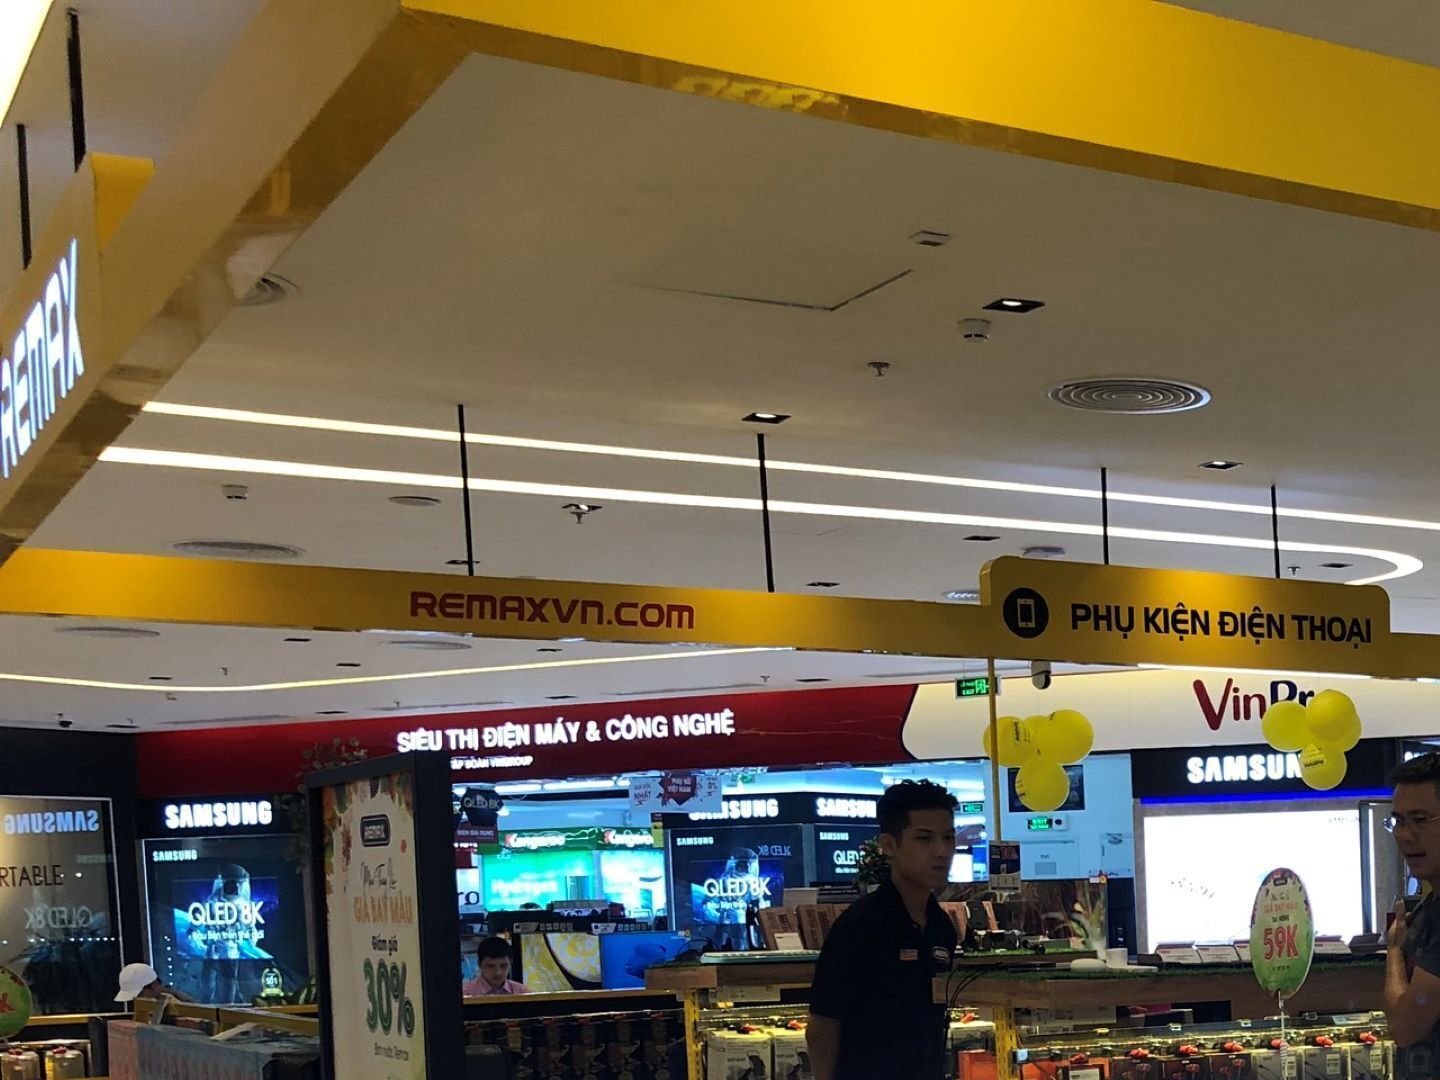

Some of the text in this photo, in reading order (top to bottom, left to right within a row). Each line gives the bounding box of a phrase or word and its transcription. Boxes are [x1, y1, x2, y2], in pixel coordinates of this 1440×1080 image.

[1071, 602, 1372, 649] PHỤ KIỆN ĐIỆN THOẠI
[397, 708, 736, 753] SIÊU THỊ ĐIỆN MÁY & CÔNG NGHỆ
[1186, 752, 1303, 784] SAMSUN
[165, 801, 272, 829] SAMSUNG
[676, 836, 714, 845] SAMSUNG
[819, 831, 849, 841] SAMSUNG
[153, 850, 198, 861] SAMSUNG
[704, 877, 771, 899] QLED 8K
[188, 901, 265, 925] QLED 8K
[1263, 925, 1299, 960] 59K
[363, 958, 415, 1037] 30%
